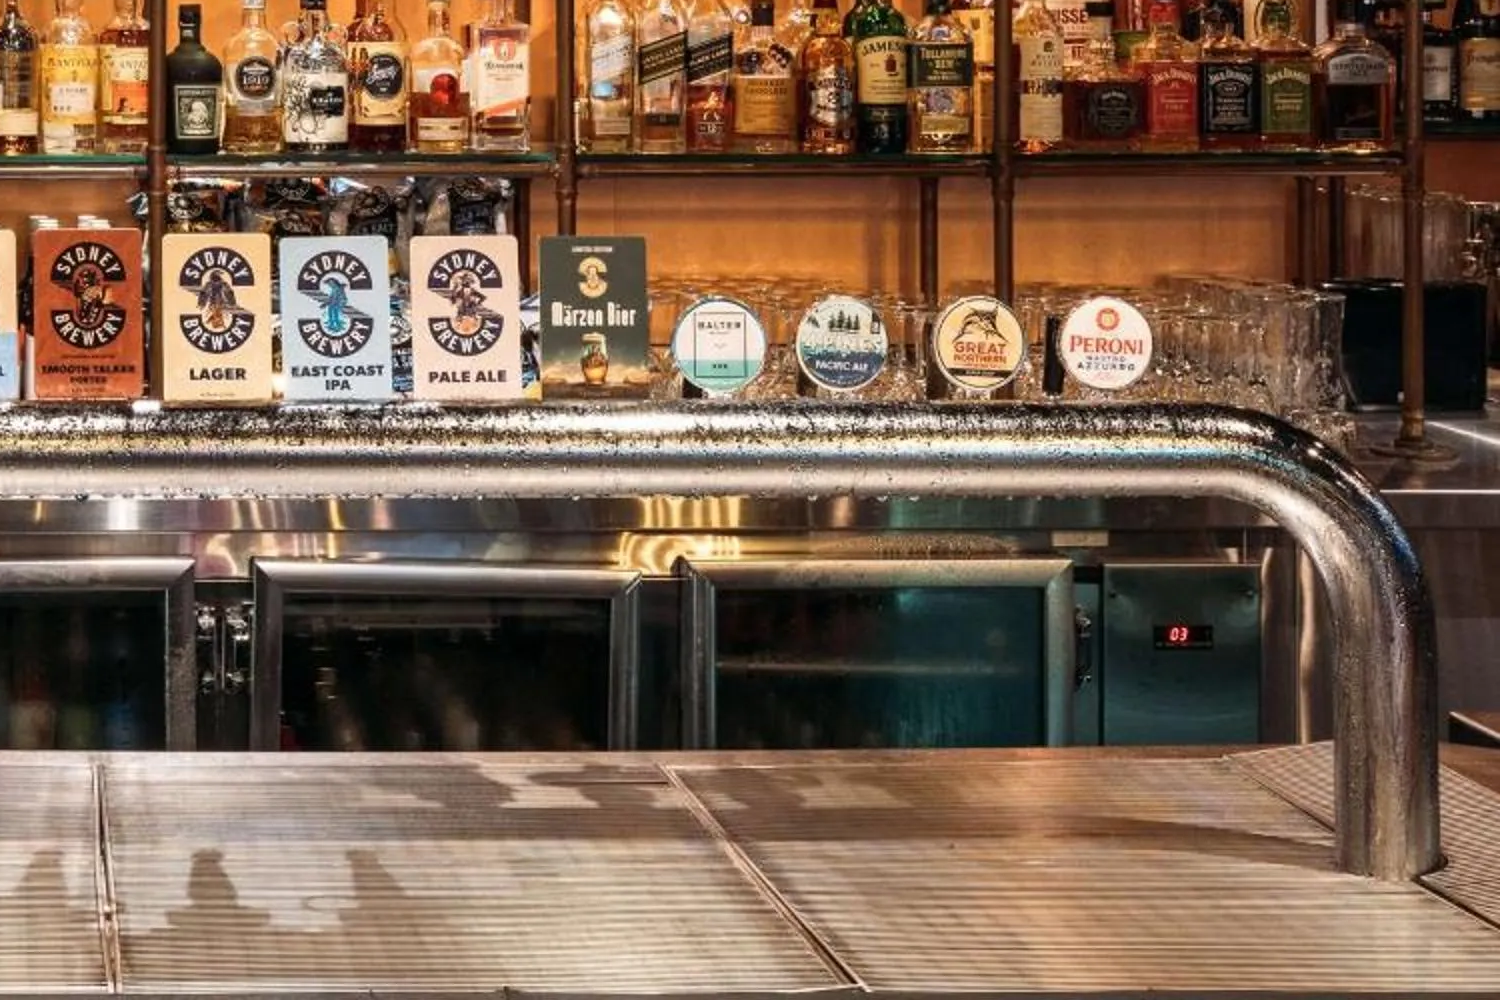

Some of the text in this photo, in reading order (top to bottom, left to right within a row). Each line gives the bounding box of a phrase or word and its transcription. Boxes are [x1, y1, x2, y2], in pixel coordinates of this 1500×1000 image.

[862, 38, 902, 56] JAMES
[57, 246, 122, 275] SYDNEY
[185, 251, 249, 279] SYDNEY
[303, 255, 367, 284] SYDNEY
[433, 253, 498, 282] SYDNEY
[551, 301, 637, 327] Märzen Bier
[55, 312, 123, 347] BREWERY
[183, 317, 251, 351] BREWERY
[301, 321, 370, 355] BREWERY
[431, 319, 500, 354] BREWERY
[954, 341, 1007, 355] GREAT
[1069, 335, 1143, 355] PERONI
[953, 354, 1007, 364] NORTHERN
[189, 367, 247, 381] LAGER
[291, 365, 385, 378] EAST COAST
[428, 370, 507, 384] PALE ALE
[324, 379, 351, 391] IPA
[1169, 627, 1189, 641] 03
